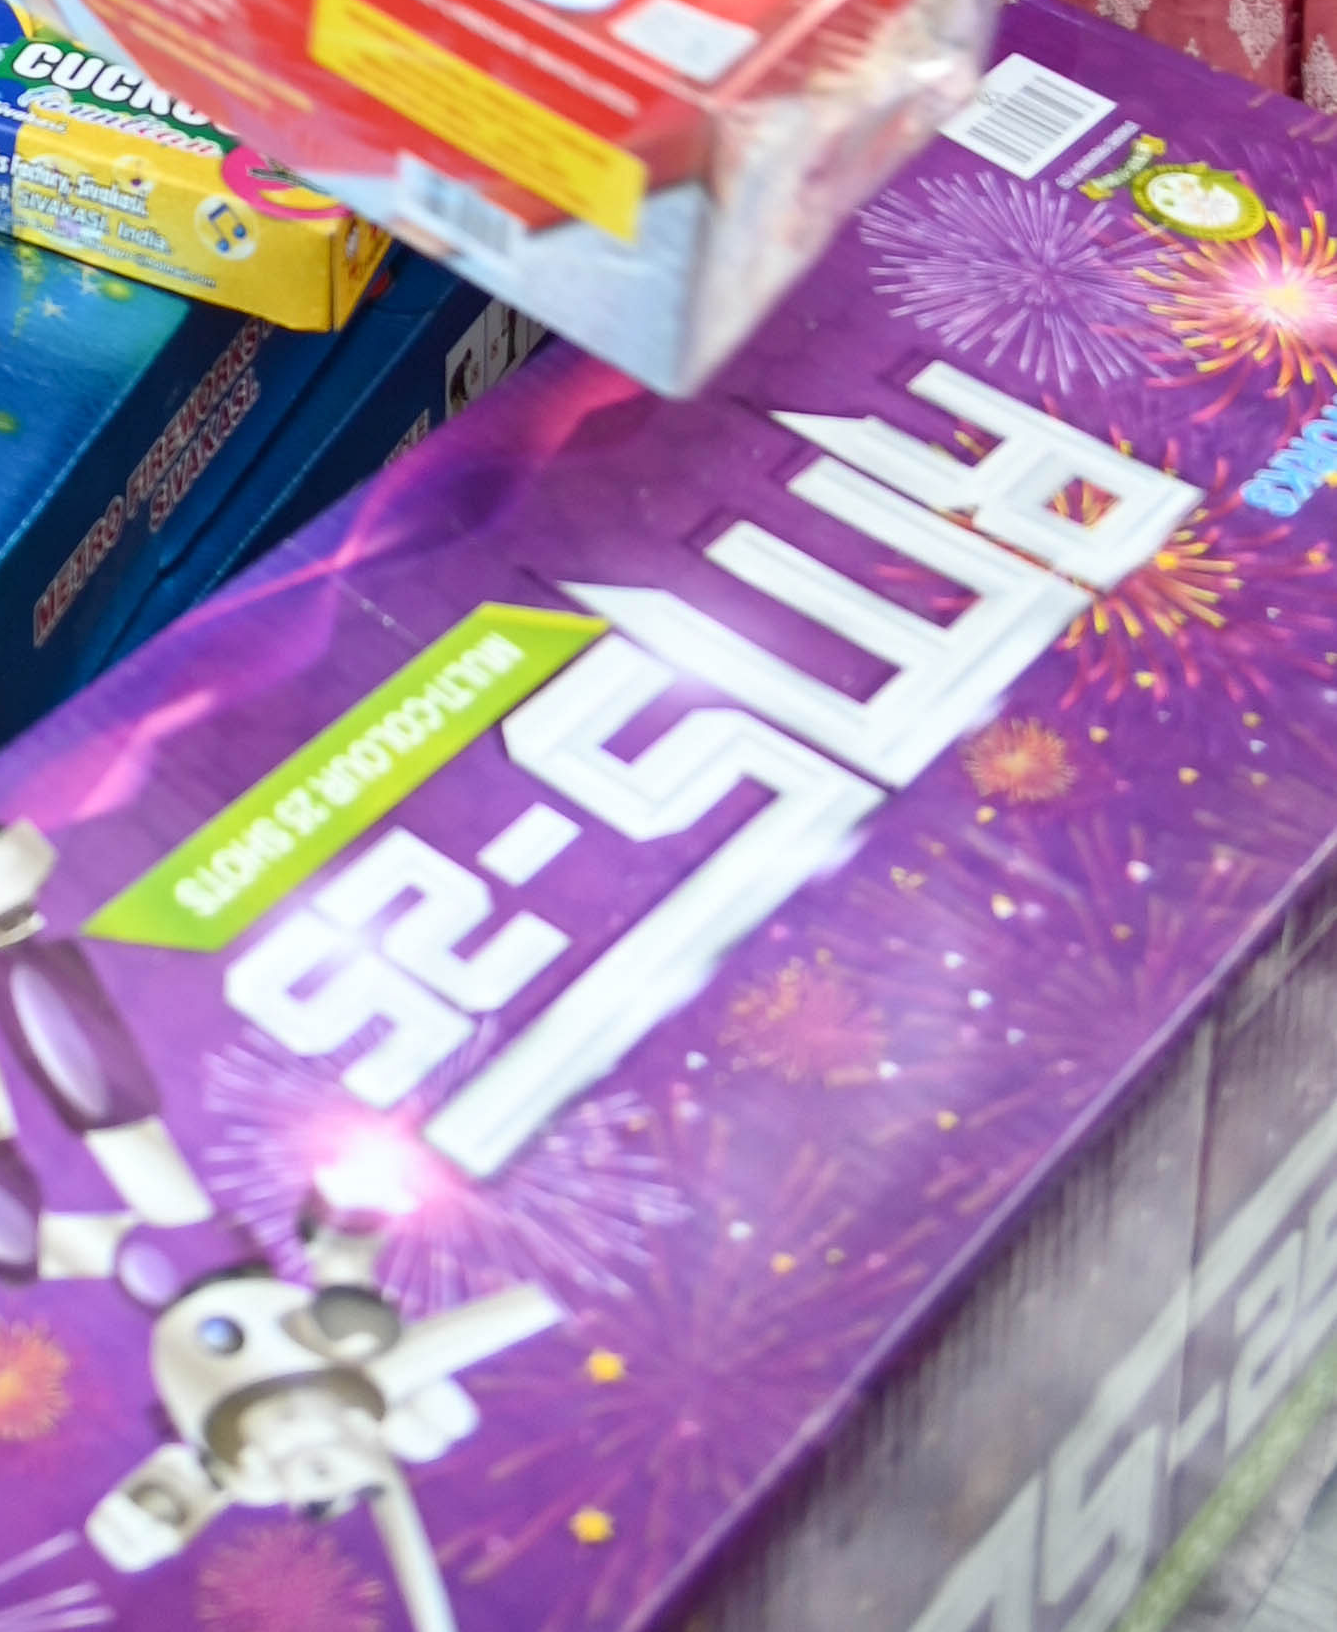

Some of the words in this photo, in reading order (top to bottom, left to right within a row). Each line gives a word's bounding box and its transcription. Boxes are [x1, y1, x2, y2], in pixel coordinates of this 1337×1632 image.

[12, 41, 241, 137] CUCK
[34, 493, 125, 648] METRO
[317, 630, 525, 812] MULTI-COLOUR
[173, 809, 295, 919] SHOTS
[269, 780, 330, 843] 25
